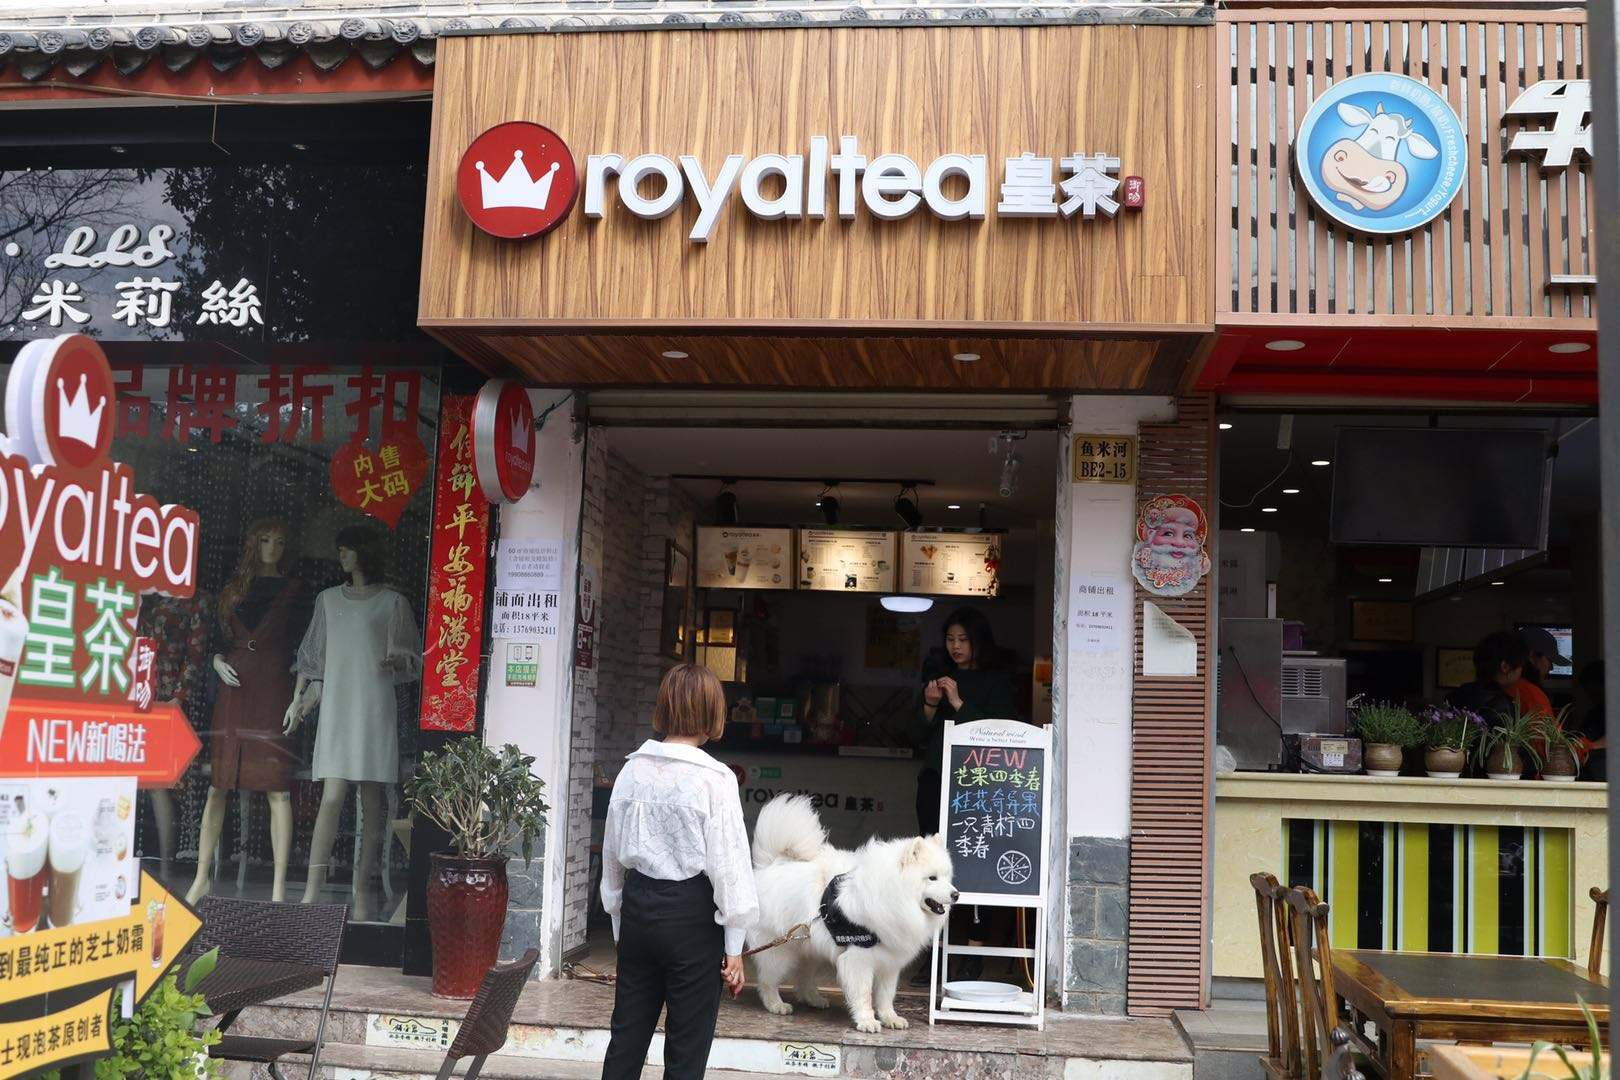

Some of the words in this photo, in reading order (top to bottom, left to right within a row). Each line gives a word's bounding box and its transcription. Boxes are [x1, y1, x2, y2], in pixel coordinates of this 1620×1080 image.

[584, 133, 986, 243] royaltea
[997, 152, 1122, 219] 皇茶
[21, 276, 264, 327] 米莉絲
[1081, 441, 1128, 457] 鱼米河
[1081, 461, 1126, 479] BE2-15
[356, 470, 410, 508] 大码
[0, 466, 196, 590] yaltea
[495, 591, 558, 608] 铺面出租
[18, 568, 136, 694] 皇茶
[963, 748, 1029, 769] NEW
[954, 766, 1041, 791] 芒果四季春
[952, 812, 1036, 838] 一只青柠四
[955, 834, 990, 859] 季春
[0, 924, 144, 980] 到最纯正的芝士奶霜
